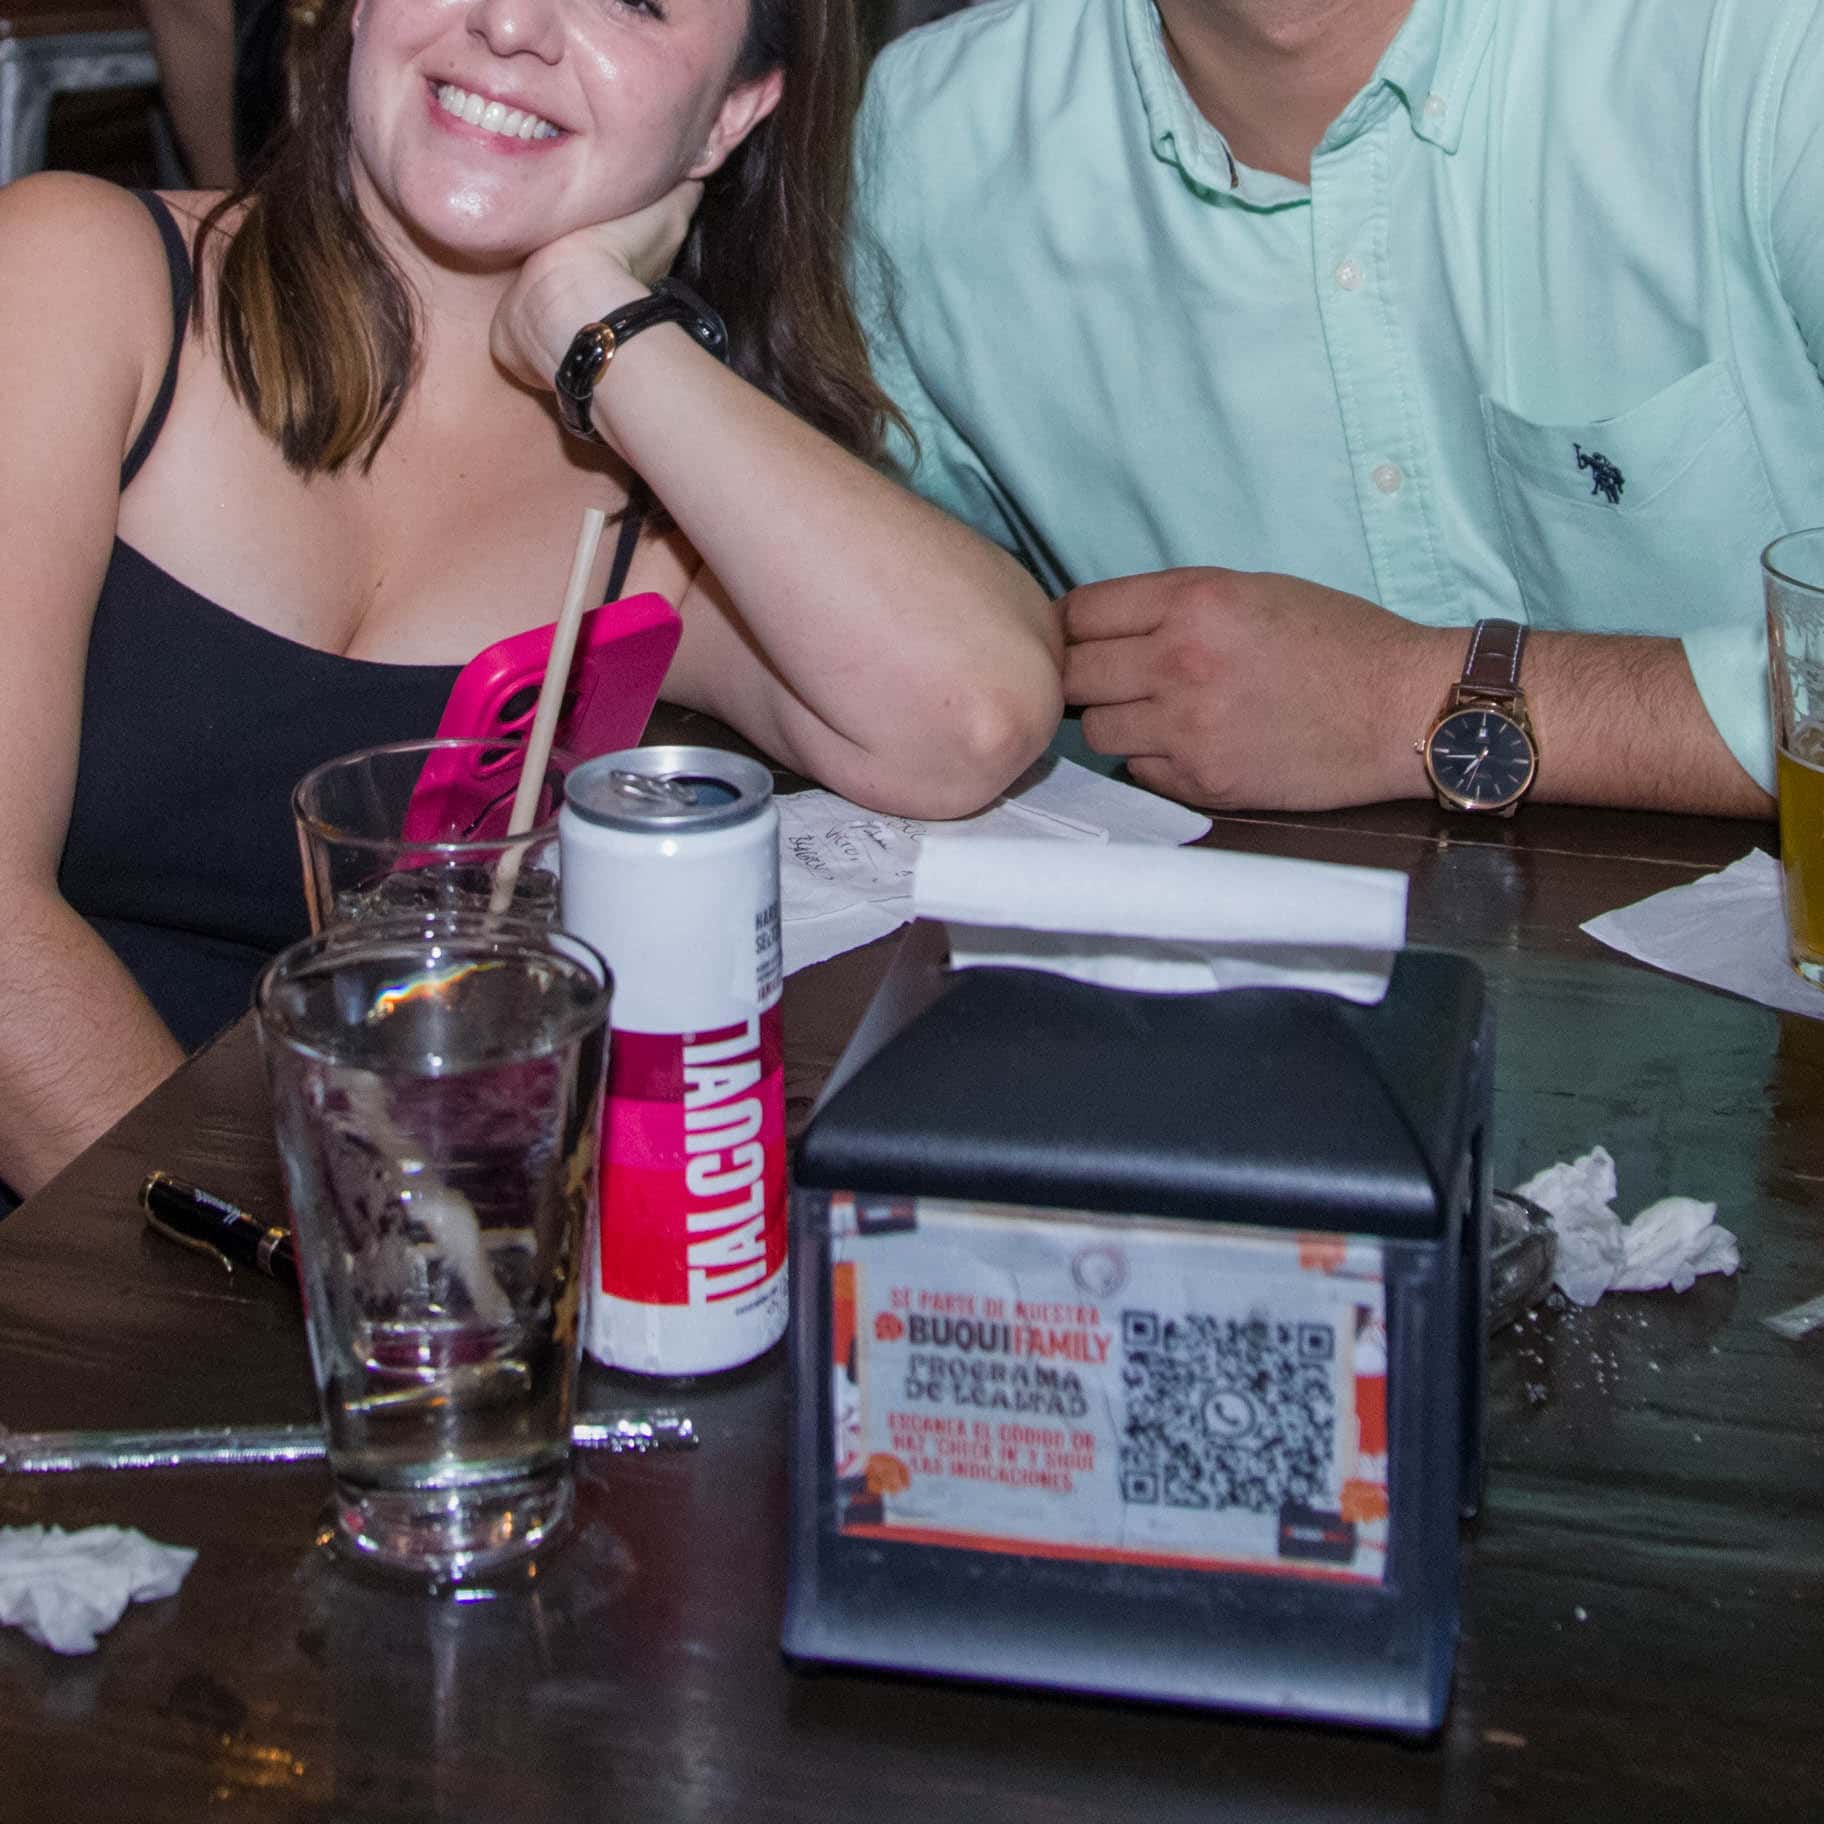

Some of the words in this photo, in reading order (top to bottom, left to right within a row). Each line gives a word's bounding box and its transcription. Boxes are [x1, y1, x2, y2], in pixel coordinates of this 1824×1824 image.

[908, 1354, 1081, 1391] PROGRAMA
[905, 1378, 943, 1402] DE
[954, 1382, 1088, 1417] LEALTAD
